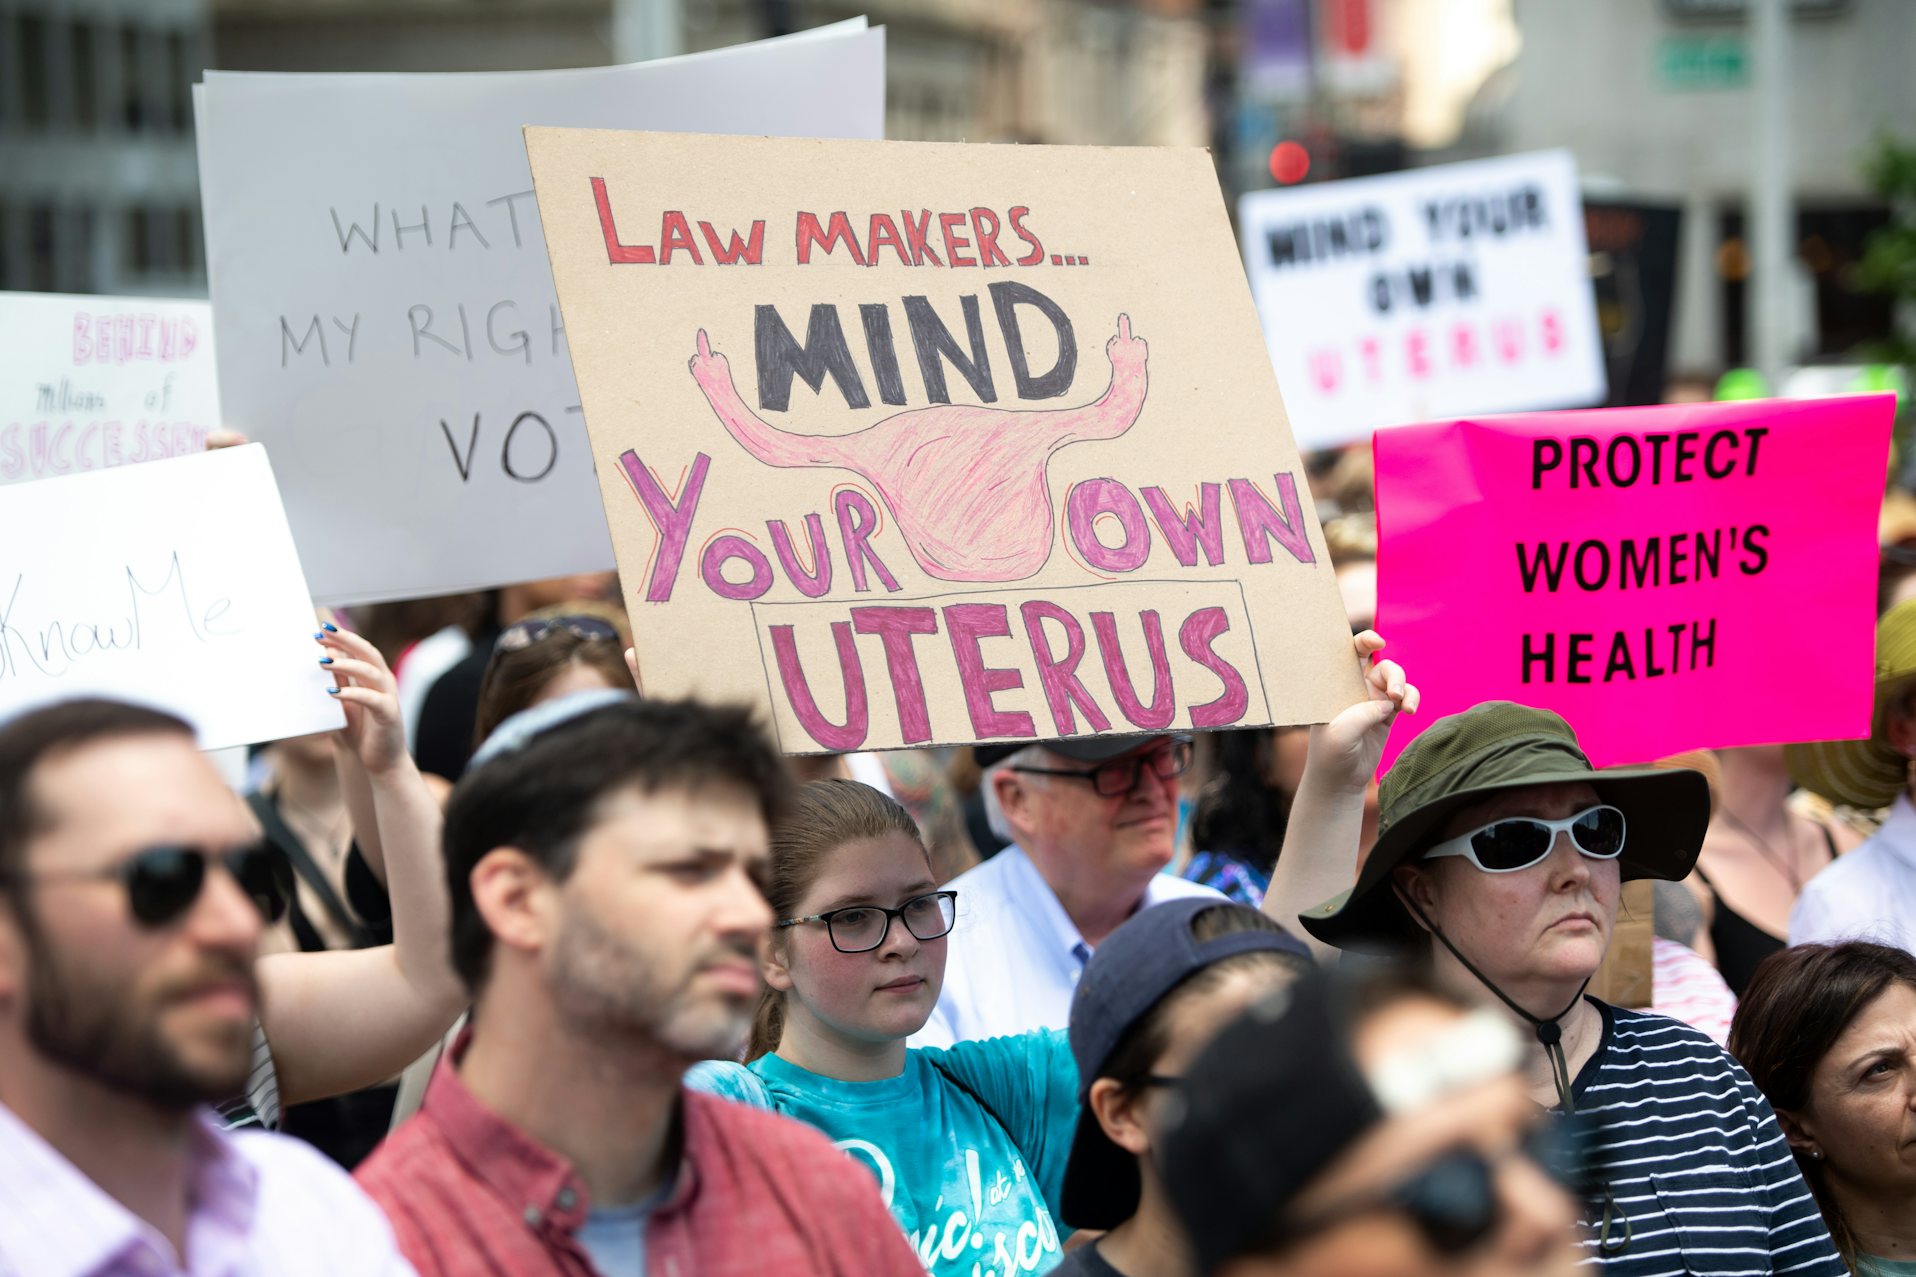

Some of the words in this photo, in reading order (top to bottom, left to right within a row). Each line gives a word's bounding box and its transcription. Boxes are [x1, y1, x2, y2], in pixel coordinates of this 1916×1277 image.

[330, 189, 535, 254] WHAT
[589, 176, 766, 265] LAW
[796, 205, 1090, 268] MAKERS...
[1265, 206, 1388, 267] MIND
[1419, 184, 1546, 242] YOUR
[1369, 260, 1478, 314] OWN
[72, 311, 198, 366] BEHIND
[279, 312, 361, 368] MY
[754, 281, 1077, 412] MIND
[1306, 308, 1567, 393] UTERUS
[144, 371, 176, 412] of
[439, 405, 597, 482] VO
[1531, 427, 1768, 490] PROTECT
[1063, 472, 1317, 571] OWN
[1515, 524, 1770, 593] WOMEN'S
[125, 550, 249, 650] Me
[768, 600, 1248, 751] UTERUS
[1520, 618, 1716, 684] HEALTH
